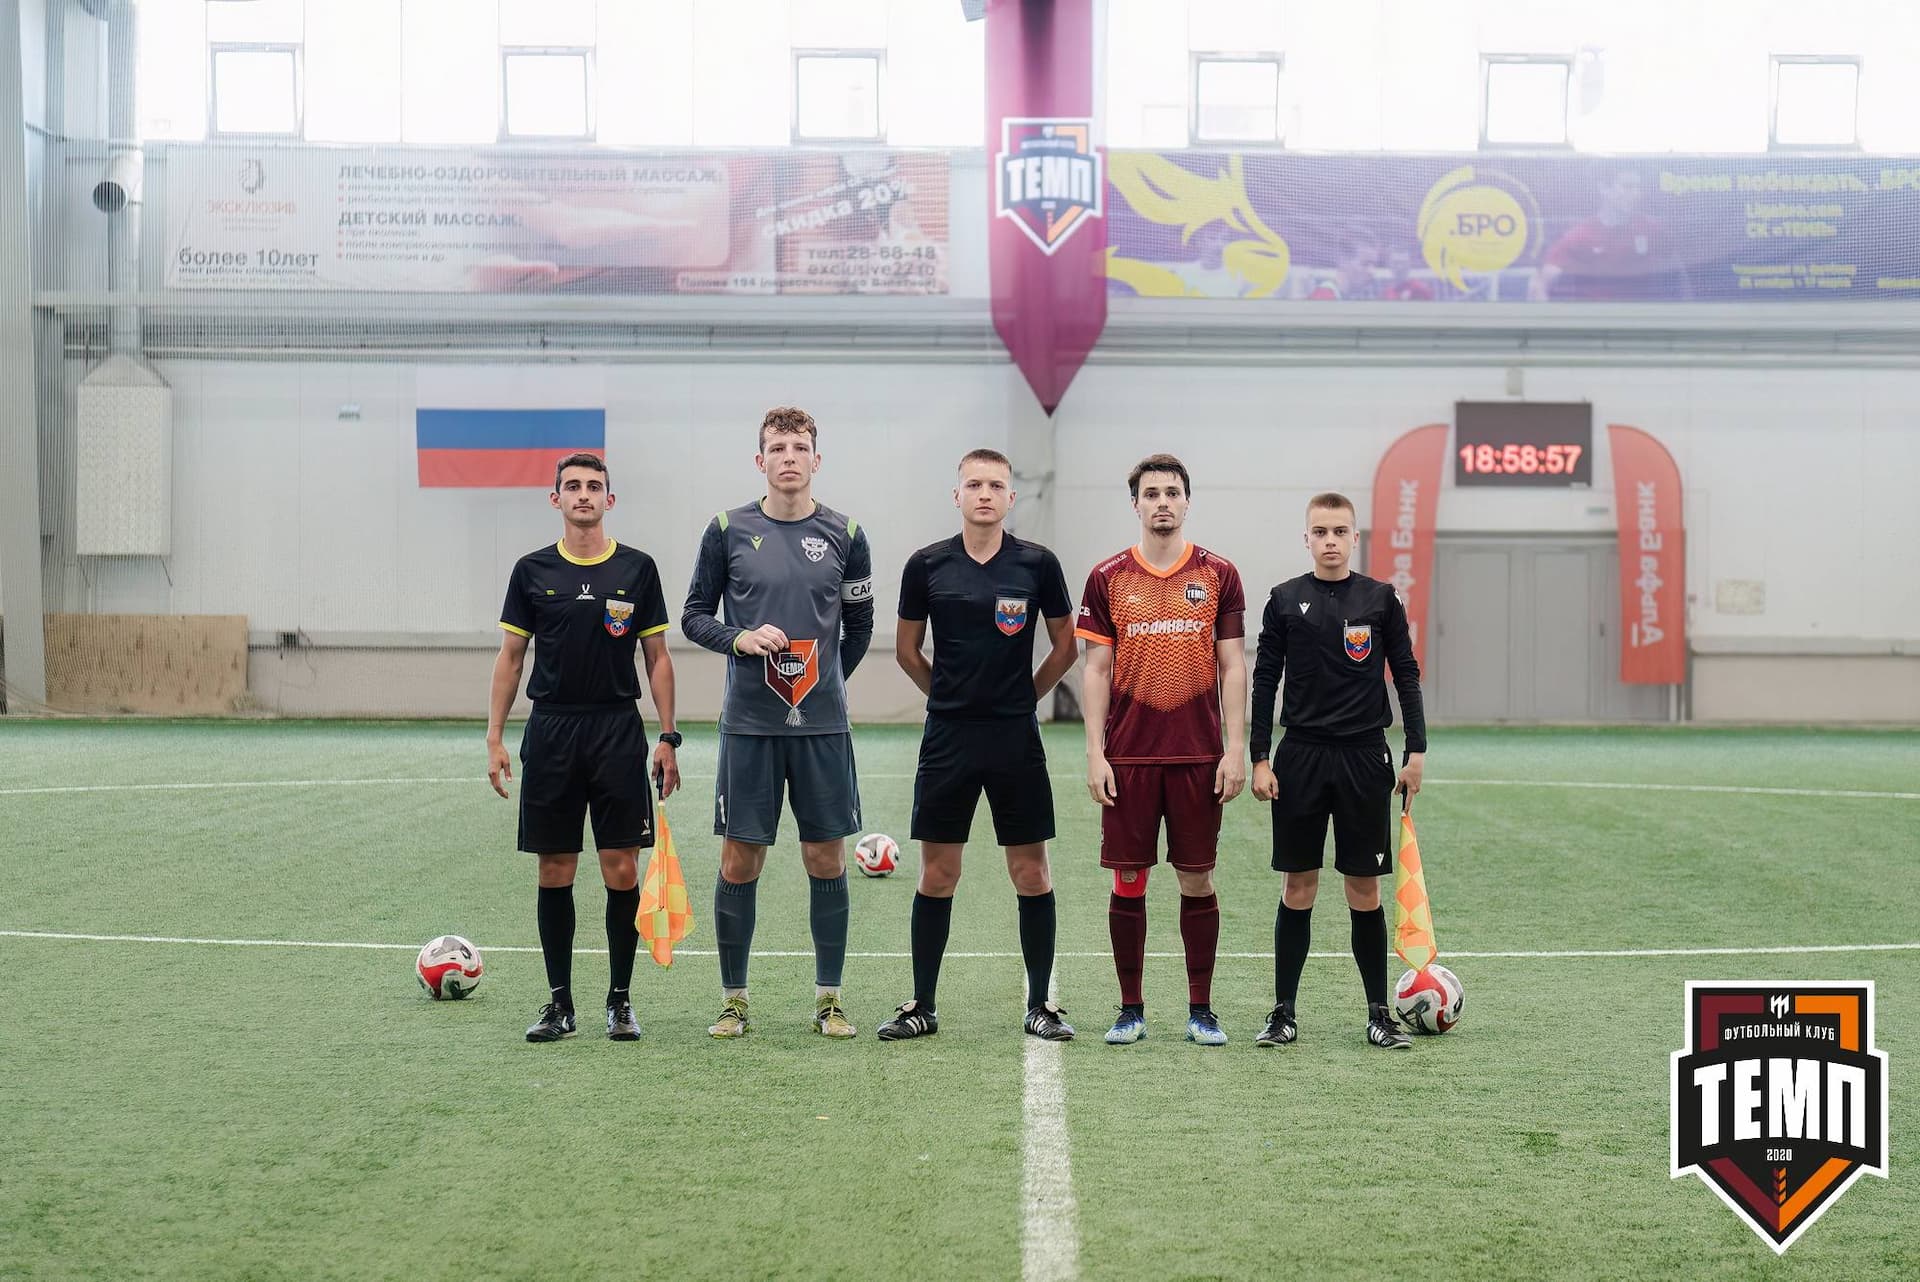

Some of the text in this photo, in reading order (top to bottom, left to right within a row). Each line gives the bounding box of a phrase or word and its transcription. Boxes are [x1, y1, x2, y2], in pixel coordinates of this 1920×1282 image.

[339, 165, 627, 183] ЛЕЧЕБНО-ОЗДОРОВИТЕЛЬНЫЙ
[1006, 156, 1092, 203] ТЕМП
[338, 210, 427, 227] ДЕТСКИЙ
[1448, 213, 1517, 237] .БРО
[179, 246, 319, 267] более 10лет
[1459, 444, 1582, 475] 18:58:57
[1391, 479, 1419, 550] Банк
